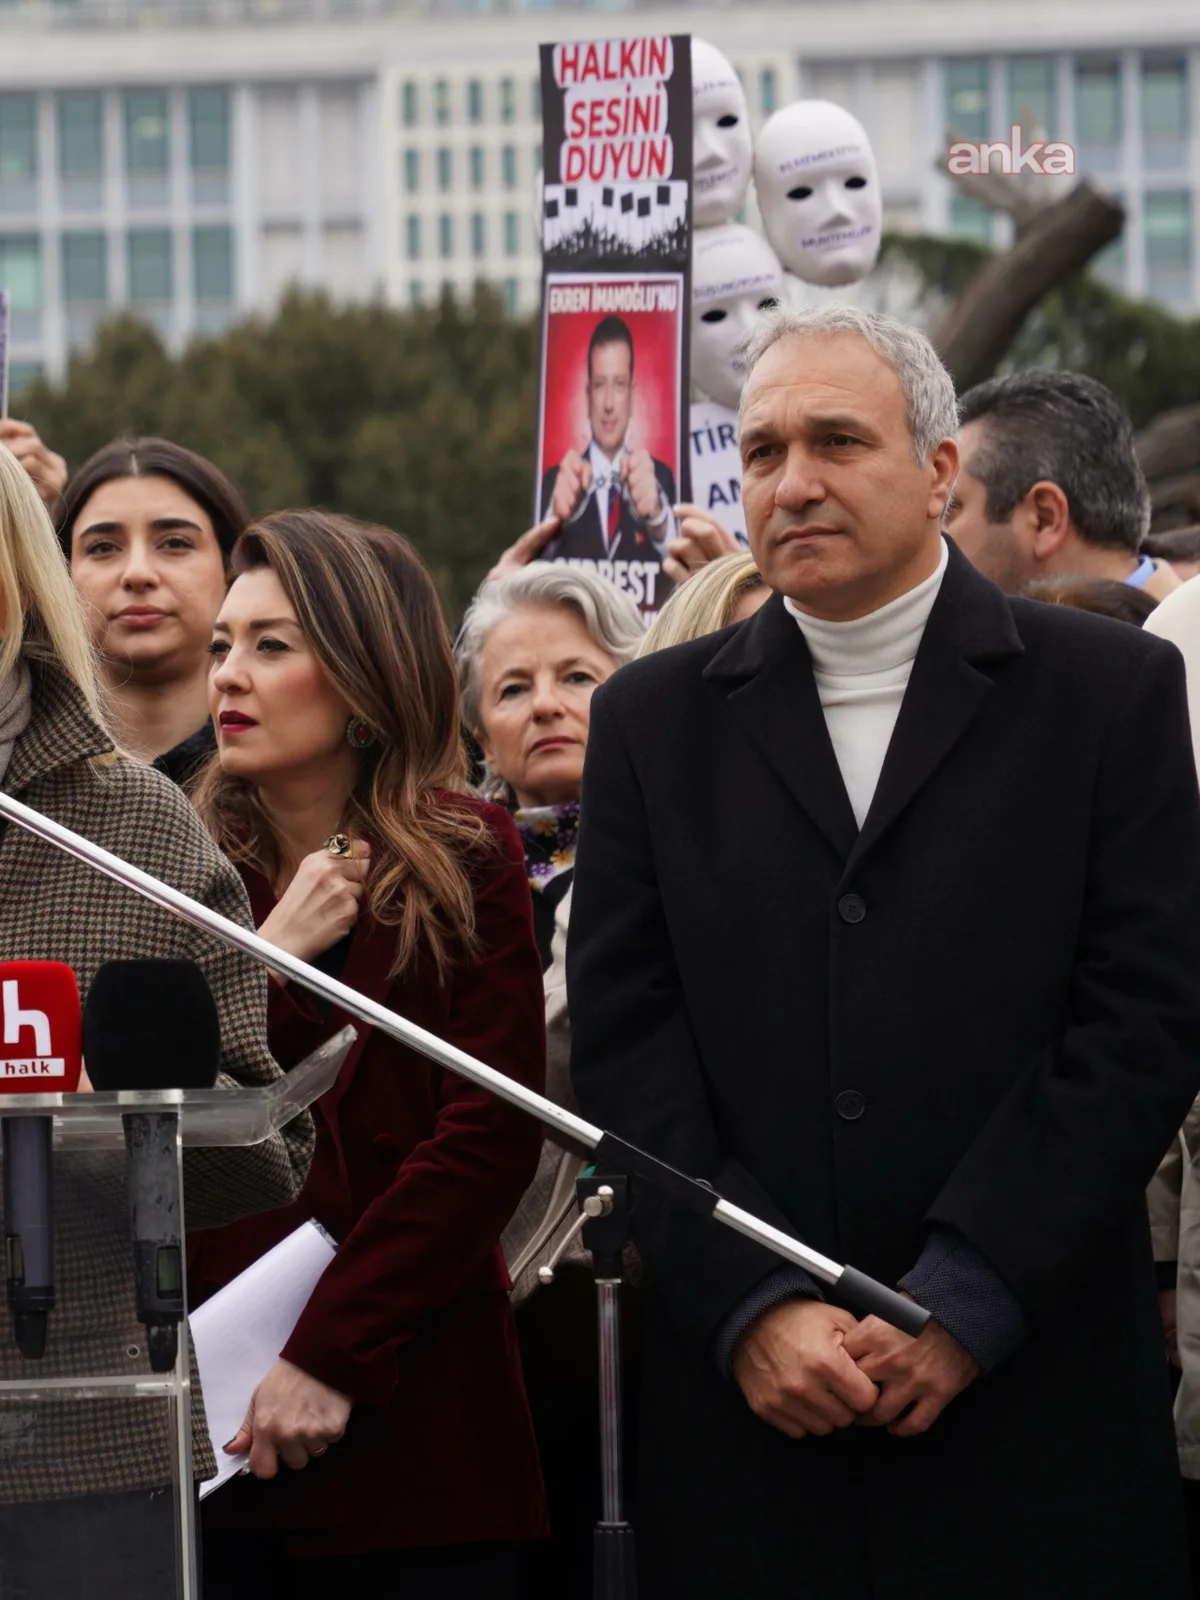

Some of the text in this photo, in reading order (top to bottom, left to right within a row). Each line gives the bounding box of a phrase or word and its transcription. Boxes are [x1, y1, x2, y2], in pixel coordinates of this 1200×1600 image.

[560, 36, 668, 85] HALKIN
[569, 80, 662, 140] SESİNİ
[565, 138, 667, 183] DUYUN
[5, 1060, 51, 1075] halk
